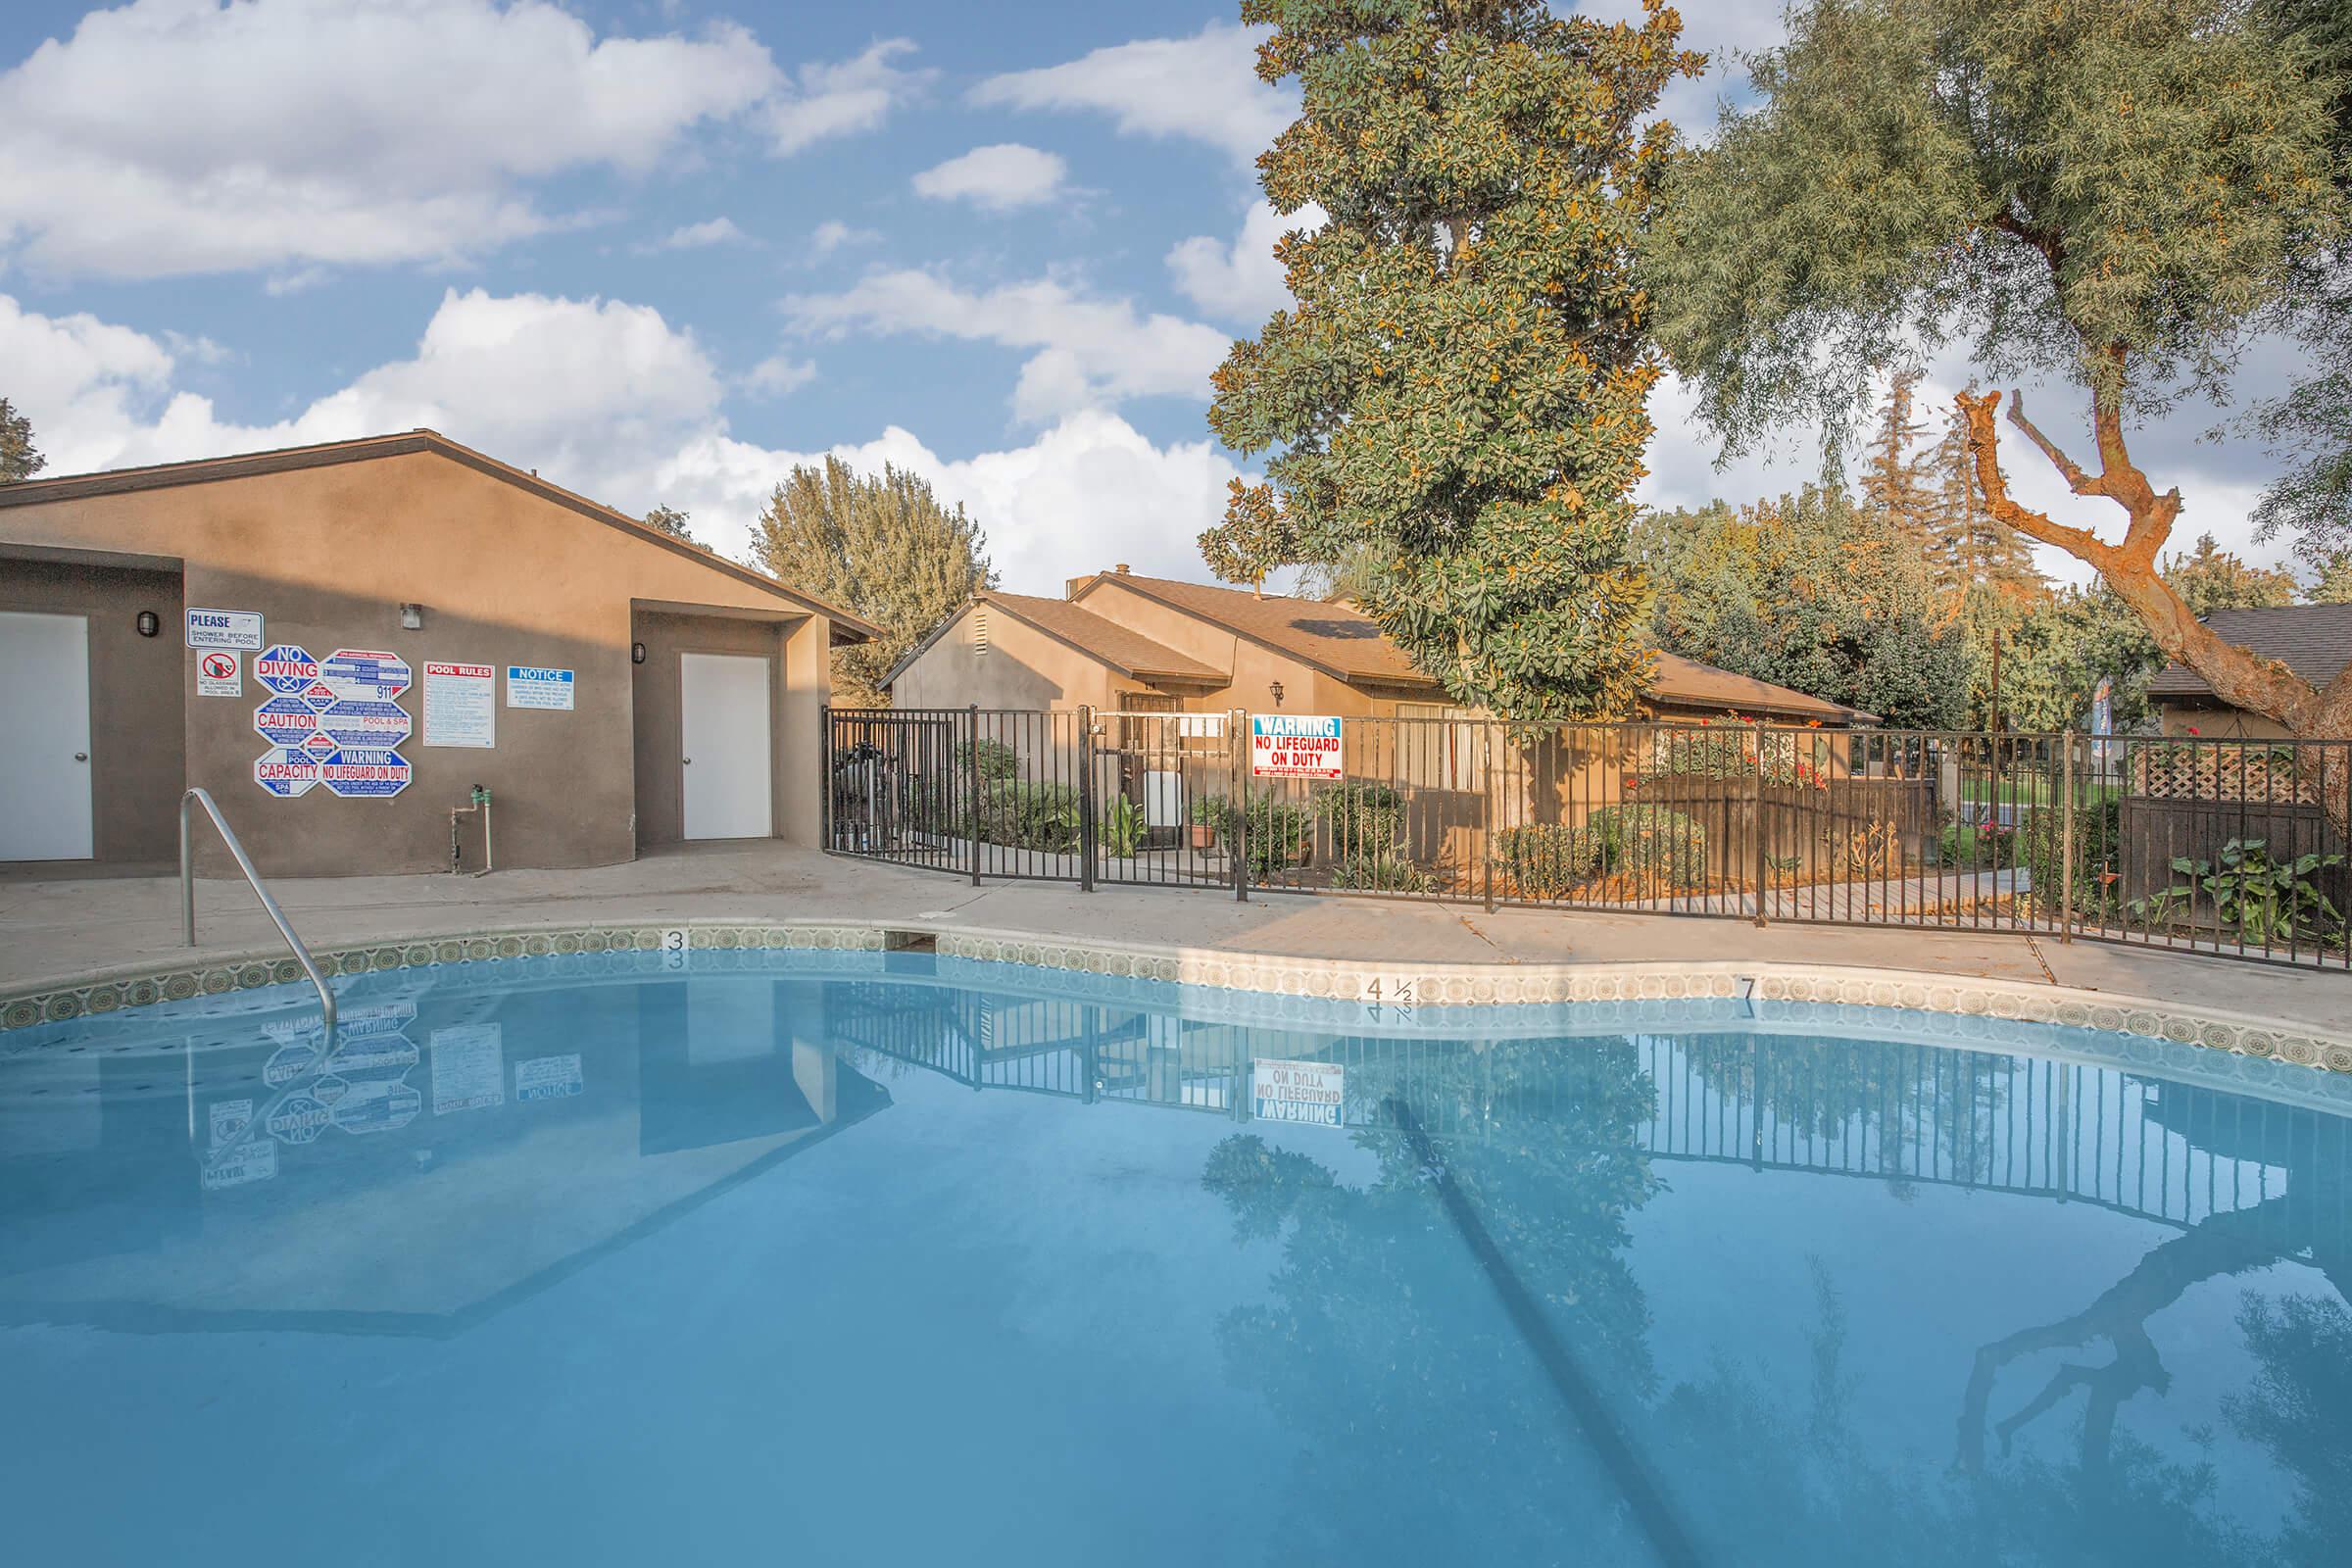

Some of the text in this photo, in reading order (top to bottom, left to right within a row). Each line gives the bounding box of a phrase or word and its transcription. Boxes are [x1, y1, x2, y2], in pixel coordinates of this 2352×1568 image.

[190, 614, 230, 628] PLEASE
[277, 647, 302, 662] NO
[258, 661, 318, 677] DIVING
[428, 665, 490, 676] POOL RULES
[518, 668, 564, 681] NOTICE
[376, 685, 392, 699] 911
[258, 713, 317, 728] CAUTION
[1259, 716, 1335, 737] WARNING
[1255, 736, 1339, 752] NO LIFEGUARD
[340, 751, 392, 764] WARNING
[1271, 752, 1323, 767] ON DUTY
[259, 764, 318, 778] CAPACITY
[322, 765, 409, 780] NO LIFEGUARD ON DUTY
[667, 931, 683, 951] 3
[1367, 977, 1383, 1000] 4
[1741, 978, 1756, 1000] 7
